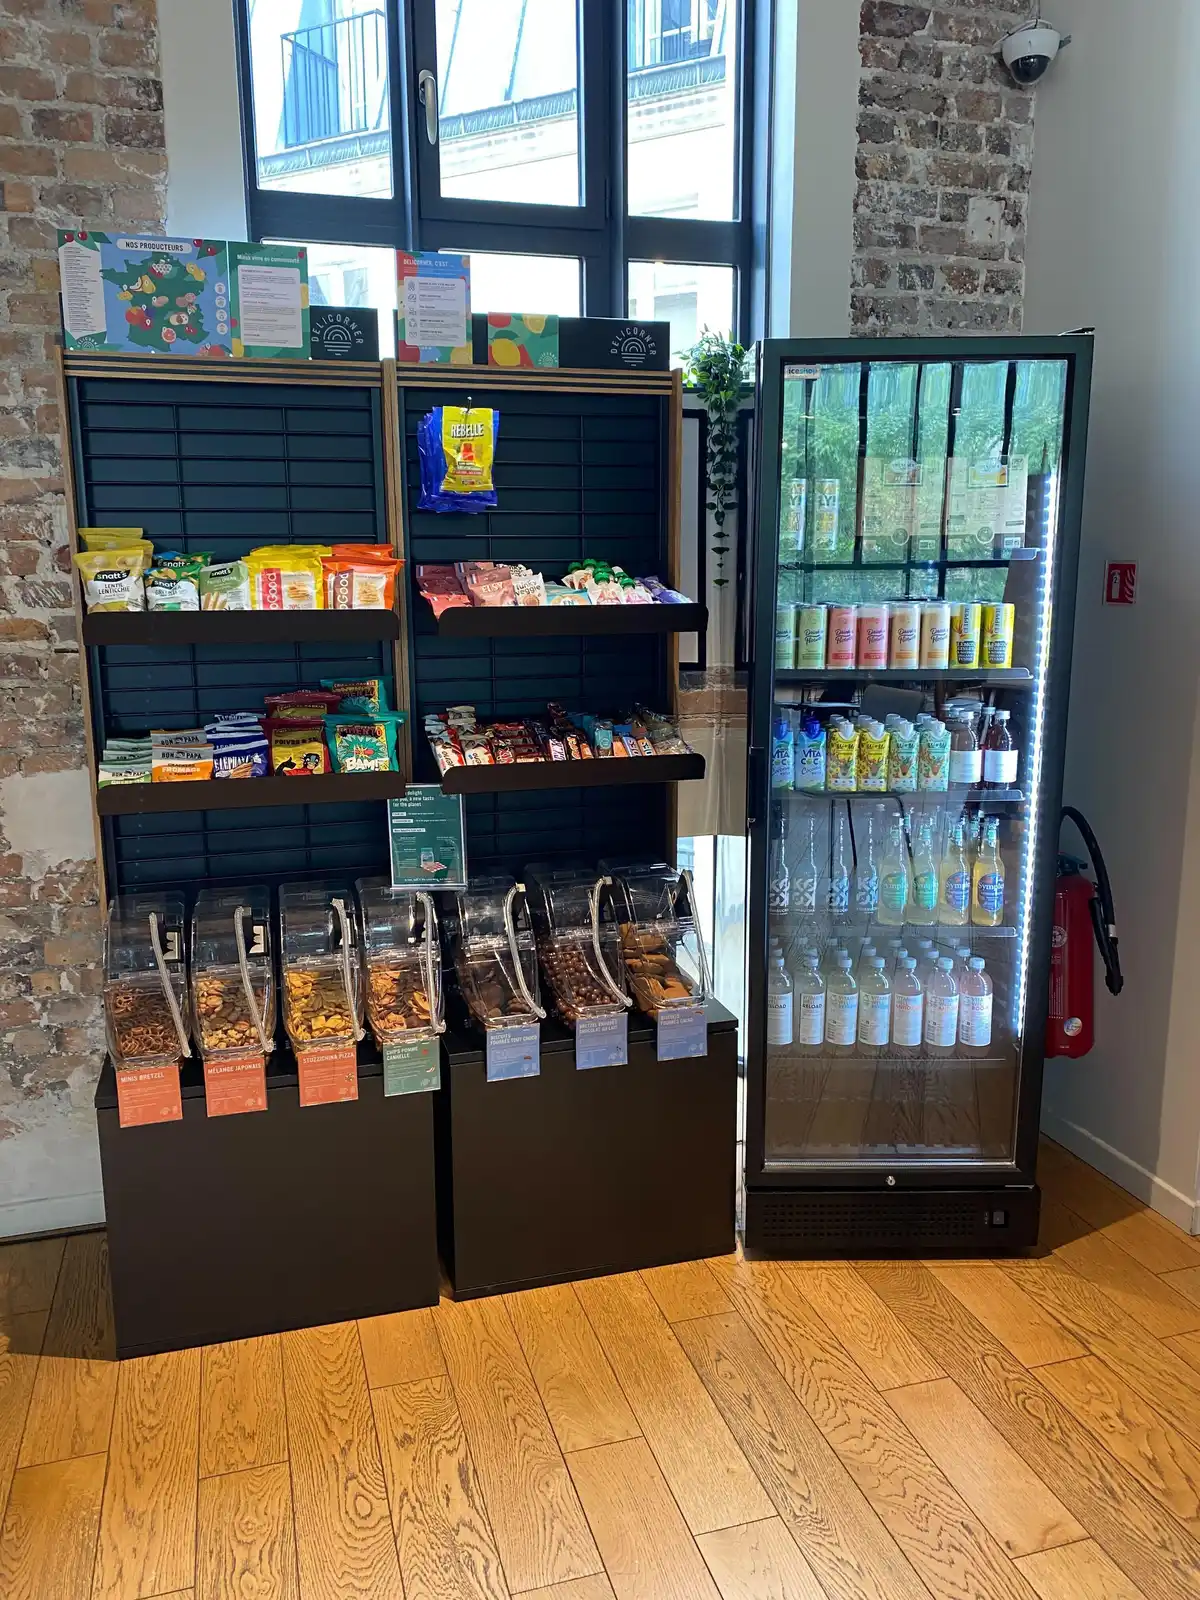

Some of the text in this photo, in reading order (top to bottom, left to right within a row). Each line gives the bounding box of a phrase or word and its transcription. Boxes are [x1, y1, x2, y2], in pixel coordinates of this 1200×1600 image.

[125, 241, 184, 252] NOS PRODUCTEURS
[311, 314, 364, 344] DELICORNER
[610, 326, 657, 355] DELICORNER
[788, 367, 817, 376] iceshop
[451, 423, 485, 438] REBELLE
[97, 570, 128, 580] snatt's
[1113, 576, 1118, 584] 2
[184, 735, 200, 743] PAPA
[186, 751, 202, 760] PAPA
[802, 748, 822, 758] VITA
[345, 757, 380, 772] BAM!
[338, 1052, 355, 1060] PIZZA
[207, 1062, 262, 1075] MÉLANGE JAPONAIS
[120, 1071, 165, 1083] MINIS BRETZEL
